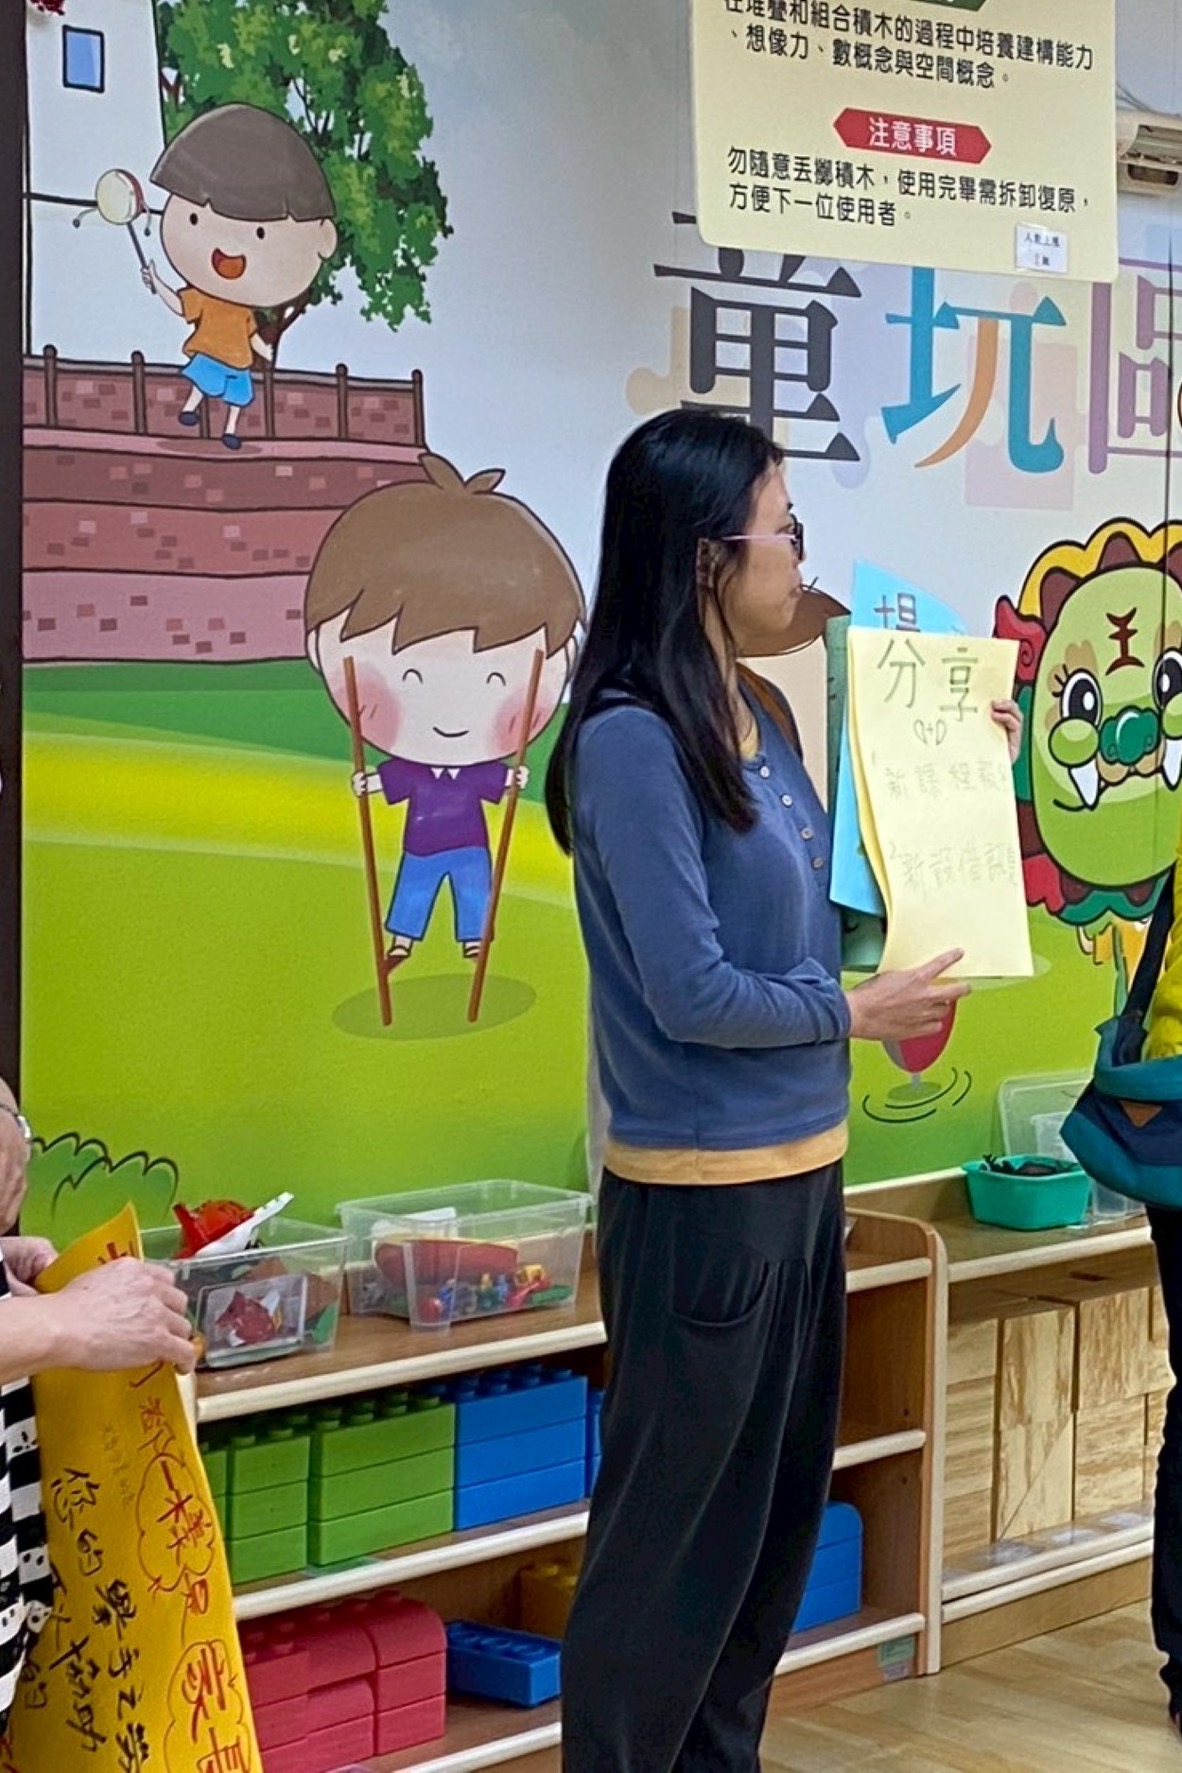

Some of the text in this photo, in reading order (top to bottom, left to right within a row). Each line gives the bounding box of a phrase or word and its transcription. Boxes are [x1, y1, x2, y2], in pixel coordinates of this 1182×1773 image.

[868, 117, 958, 158] 注意事項
[729, 183, 911, 226] 方便下一位使用者。
[877, 638, 979, 722] 分享
